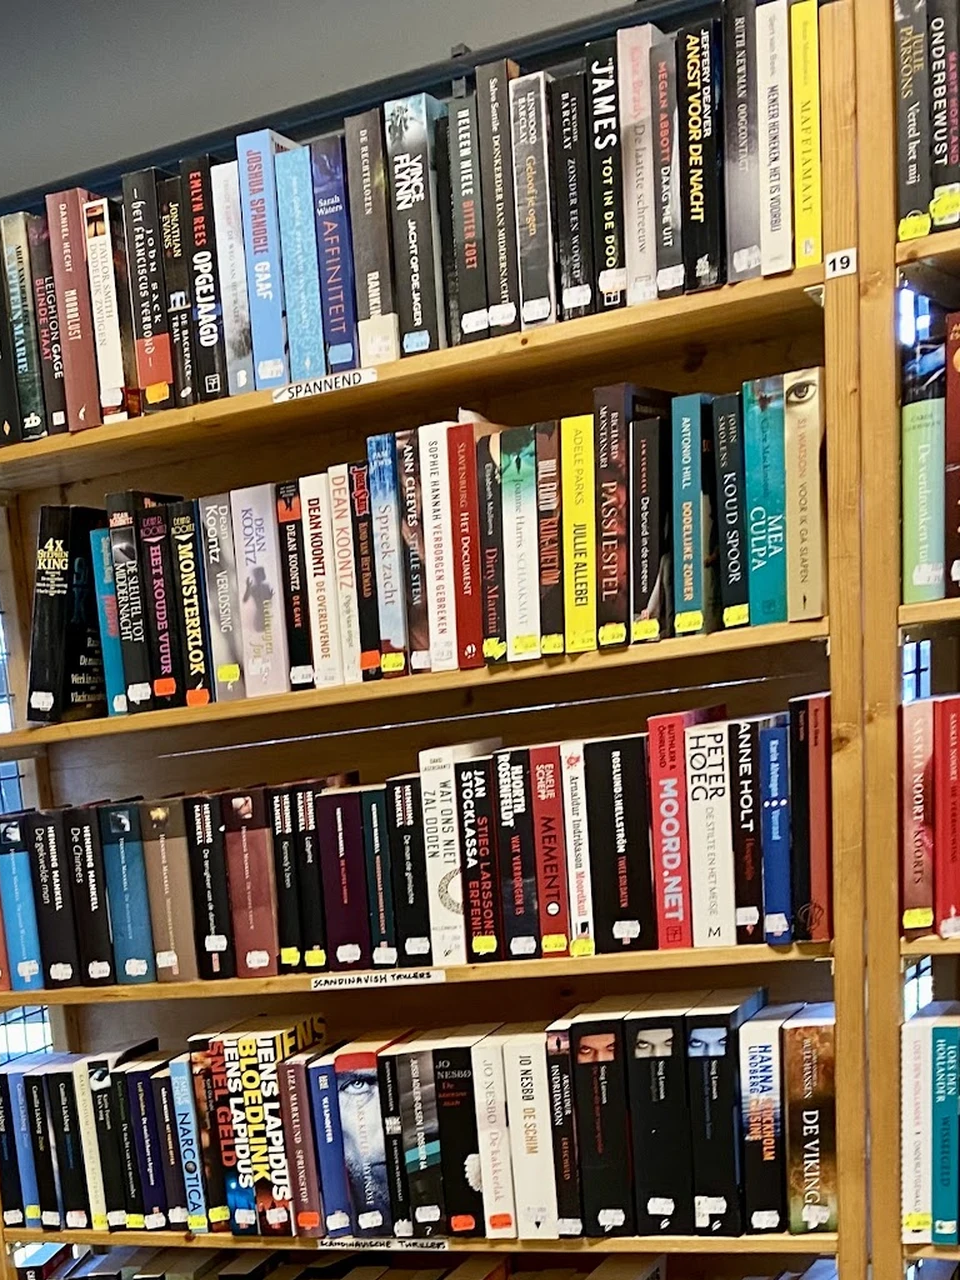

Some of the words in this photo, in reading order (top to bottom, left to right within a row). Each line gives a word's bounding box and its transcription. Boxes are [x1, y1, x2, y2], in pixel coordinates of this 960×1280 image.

[686, 35, 700, 90] ANGST
[701, 29, 710, 85] JEFFERY
[900, 25, 914, 100] PARSONS
[591, 60, 618, 151] JAMES
[658, 62, 668, 108] MEGAN
[931, 16, 948, 166] ONDERBEWUST
[457, 108, 471, 157] HELEEN
[688, 89, 703, 142] VOOR
[702, 85, 712, 137] DEAVER
[659, 111, 671, 162] ABBOTT
[689, 144, 703, 168] DE
[907, 138, 920, 158] het
[189, 171, 204, 216] EMLYN
[246, 149, 264, 196] JOSHUA
[394, 154, 413, 211] FLYNN
[408, 154, 424, 201] VINCE
[460, 159, 474, 196] NIELE
[601, 157, 613, 185] TOT
[690, 168, 705, 223] NACHT
[906, 160, 920, 186] mij
[317, 204, 343, 217] Waters
[318, 195, 340, 207] Sarah
[603, 194, 614, 207] IN
[604, 212, 615, 234] DE
[192, 216, 207, 247] REES
[252, 200, 269, 255] SPANOGLE
[322, 220, 347, 333] AFFINITEIT
[464, 241, 477, 269] ZOET
[606, 241, 617, 269] DOO
[828, 255, 851, 272] 19
[193, 251, 219, 347] OPGEJAAGD
[254, 261, 273, 300] GAAF
[41, 335, 53, 362] HAAT
[44, 276, 60, 344] LEIGHTON
[52, 345, 64, 380] GAGE
[288, 370, 362, 399] SPANNEND
[402, 444, 414, 472] ANN
[682, 417, 691, 462] ANTONIO
[404, 474, 420, 527] CLEEVES
[682, 464, 692, 490] HILL
[722, 471, 739, 526] KOUD
[205, 505, 221, 564] Koontz
[307, 498, 320, 533] DEAN
[751, 506, 768, 572] CULPA
[765, 515, 785, 559] MEA
[37, 559, 68, 570] KING
[149, 545, 163, 575] HET
[309, 535, 325, 578] KOONTZ
[572, 522, 587, 560] JULLIE
[600, 480, 620, 602] PASSIESPEL
[724, 528, 741, 586] SPOOR
[114, 563, 134, 641] MIDDERNACHT
[127, 575, 142, 617] SLEUTEL
[152, 578, 168, 632] KOUDE
[216, 571, 233, 633] VERLOSSING
[574, 561, 589, 607] ALLEBEI
[133, 619, 145, 642] TOT
[178, 543, 206, 676] MONSTERKLOK
[315, 596, 331, 660] OVERLEVENDE
[157, 633, 171, 675] VUUR
[689, 735, 711, 802] HØEG
[706, 732, 725, 801] PETER
[737, 721, 752, 777] ANNE
[474, 770, 486, 799] JAN
[497, 751, 515, 829] ROSENFELDT
[511, 765, 526, 814] HJORTH
[739, 779, 754, 833] HOLT
[70, 827, 81, 844] De
[461, 771, 478, 869] STOCKLASSA
[46, 826, 60, 870] HENNING
[71, 845, 85, 884] Chinees
[658, 778, 684, 923] MOORD.NET
[49, 870, 64, 912] MANKELL
[208, 1040, 226, 1103] SNEL
[223, 1038, 243, 1096] JENS
[255, 1037, 278, 1101] JENS
[239, 1038, 271, 1182] BLOEDLINK
[801, 1109, 819, 1136] DE
[216, 1105, 237, 1167] GELD
[229, 1097, 254, 1190] LAPIDUS
[263, 1102, 291, 1202] LAPIDUS
[178, 1112, 202, 1213] NARCOTICA
[801, 1139, 821, 1205] VIKING
